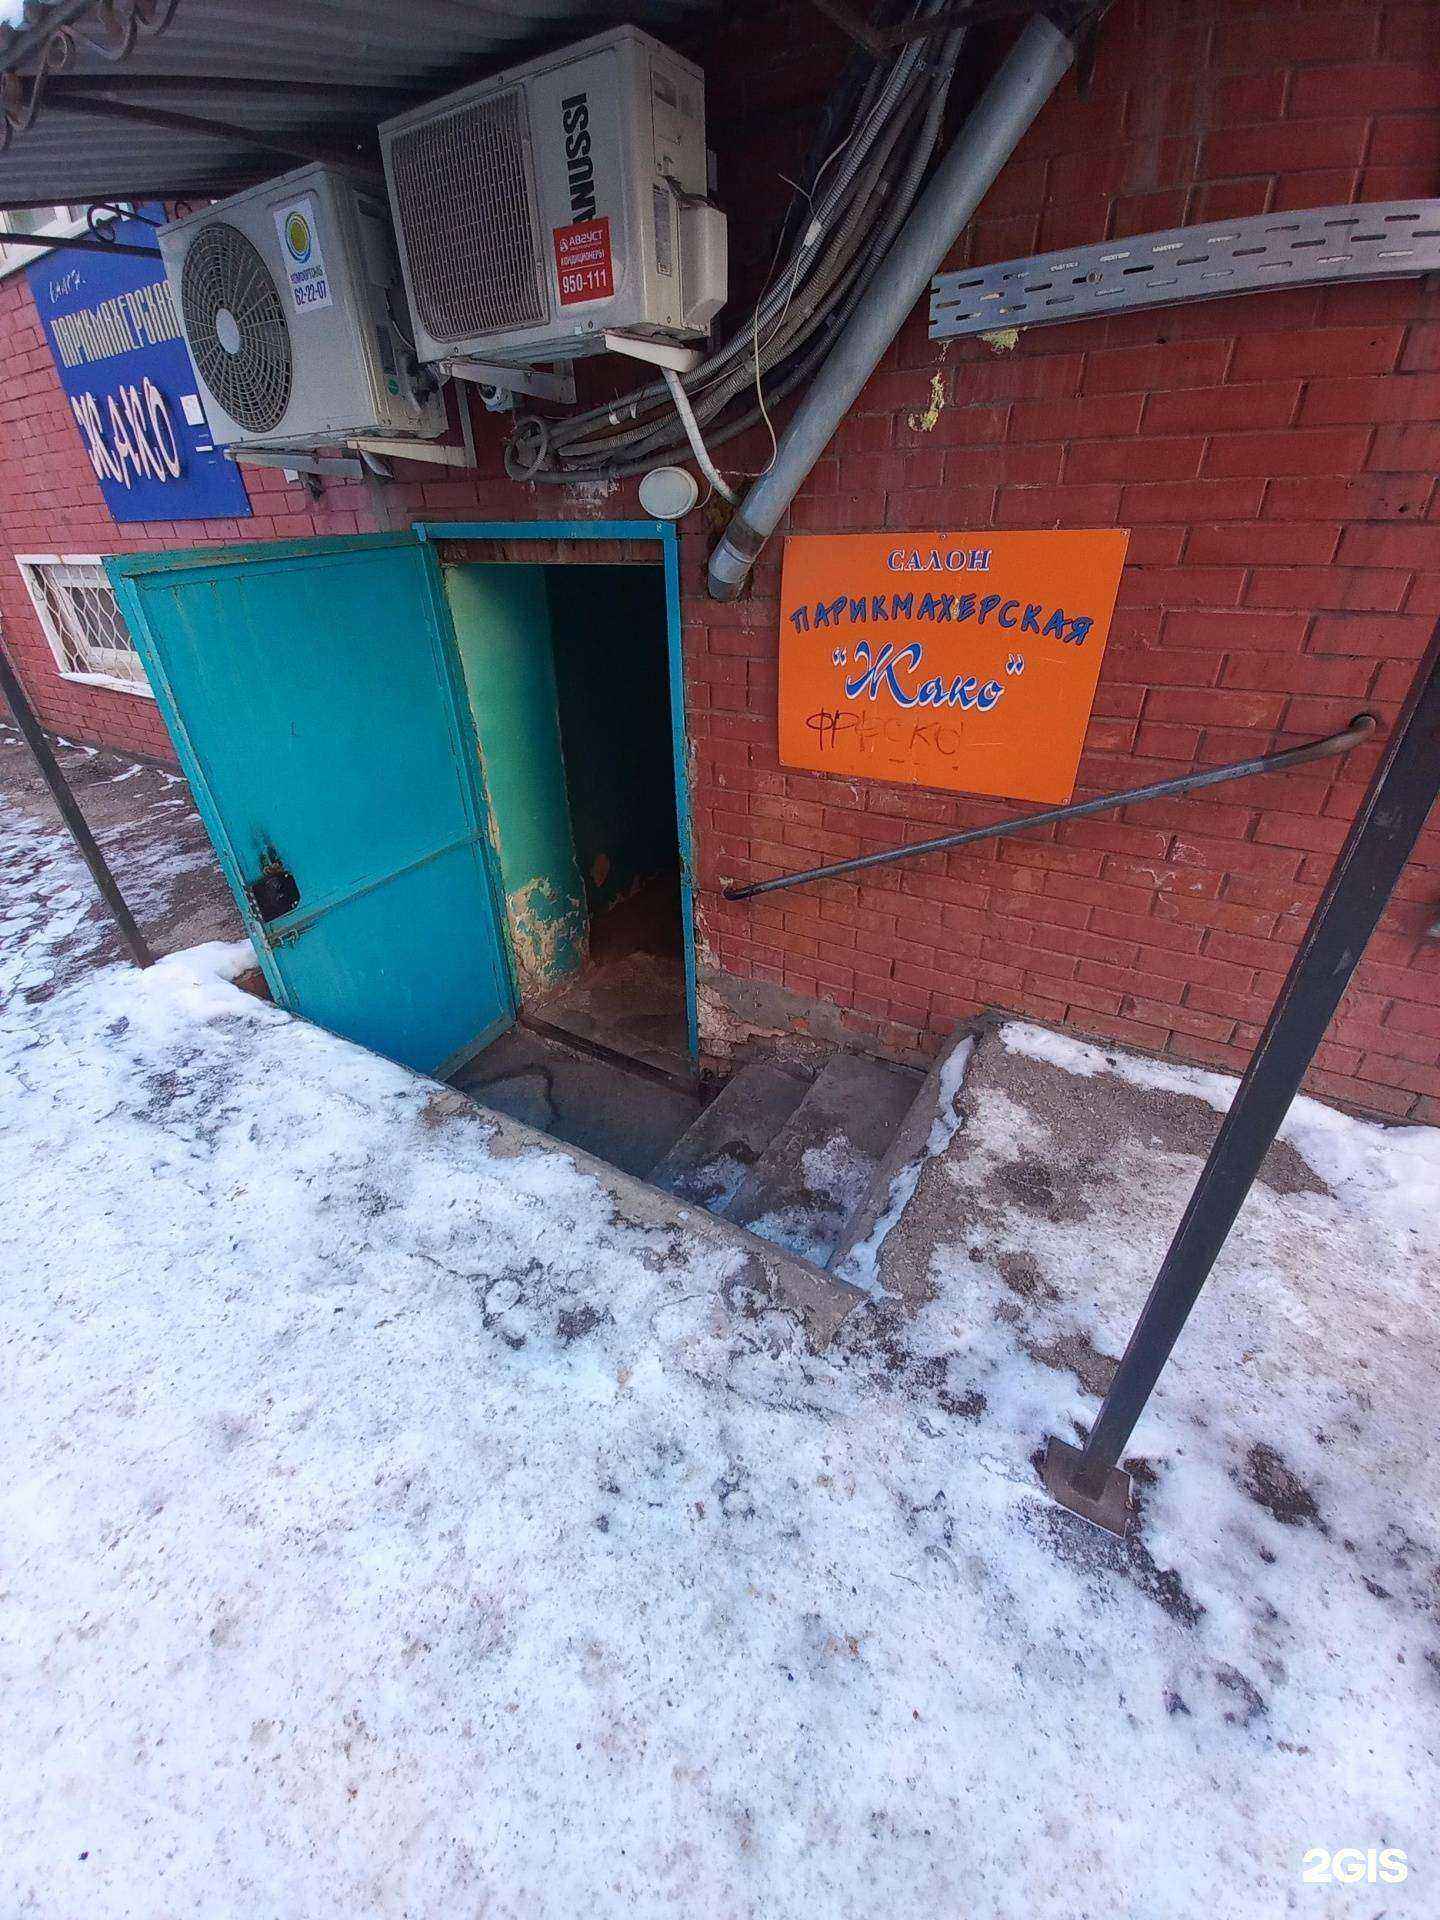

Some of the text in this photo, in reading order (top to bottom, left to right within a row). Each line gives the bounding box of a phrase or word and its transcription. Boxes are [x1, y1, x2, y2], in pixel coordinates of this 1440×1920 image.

[562, 268, 608, 294] 950-111
[70, 377, 180, 490] ЖАКО
[886, 547, 993, 573] САЛОН
[788, 591, 1096, 646] ПАРИКМАХЕРСКАЯ
